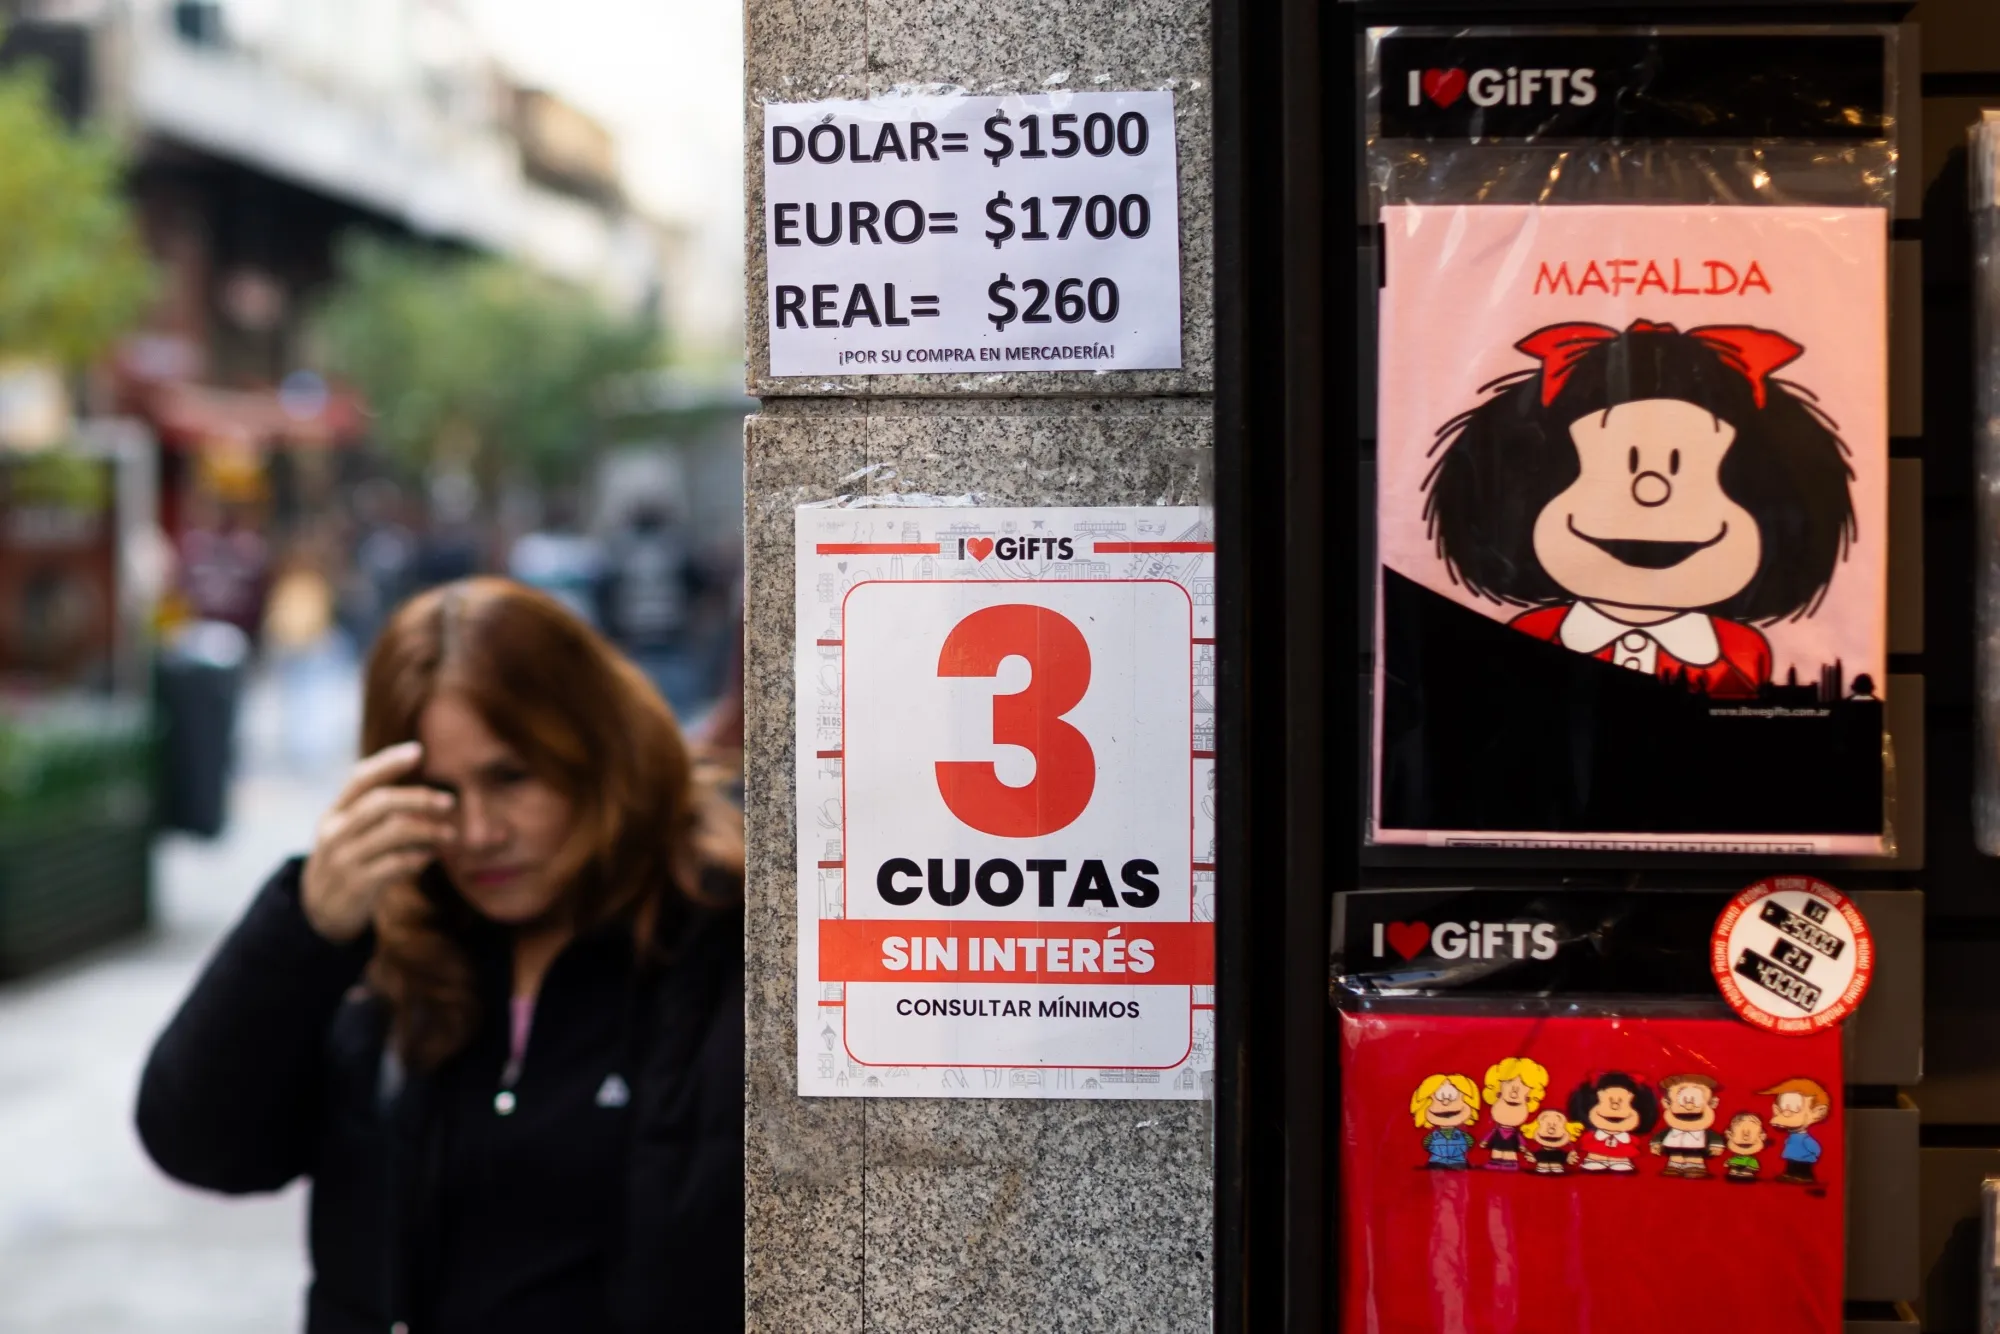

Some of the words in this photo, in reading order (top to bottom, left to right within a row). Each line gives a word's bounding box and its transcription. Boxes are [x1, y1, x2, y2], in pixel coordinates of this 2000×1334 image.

[1408, 70, 1420, 106] I
[1468, 67, 1597, 107] GiFTS
[772, 112, 968, 165] DÓLAR=
[983, 108, 1149, 167] $1500
[773, 199, 958, 247] EURO=
[984, 190, 1151, 249] $1700
[1532, 258, 1773, 297] MAFALDA
[775, 282, 940, 330] REAL=
[987, 272, 1120, 331] $260
[838, 350, 878, 365] ¡POR
[881, 349, 902, 363] SU
[906, 347, 976, 363] COMPRA
[980, 347, 1001, 361] EN
[1005, 341, 1116, 361] MERCADERÍA!
[957, 538, 966, 561] I
[995, 536, 1074, 561] GiFTS
[934, 604, 1096, 838] 3
[876, 857, 1160, 908] CUOTAS
[1717, 905, 1741, 936] PROMO
[881, 936, 958, 972] SIN
[968, 926, 1155, 974] INTERÉS
[1373, 923, 1384, 957] I
[1431, 921, 1558, 960] GiFTS
[1714, 940, 1729, 973] PROMO
[1857, 938, 1870, 970] PROMO
[896, 998, 1032, 1017] CONSULTAR
[1038, 995, 1140, 1019] MÍNIMOS
[1842, 973, 1867, 1004] PROMO
